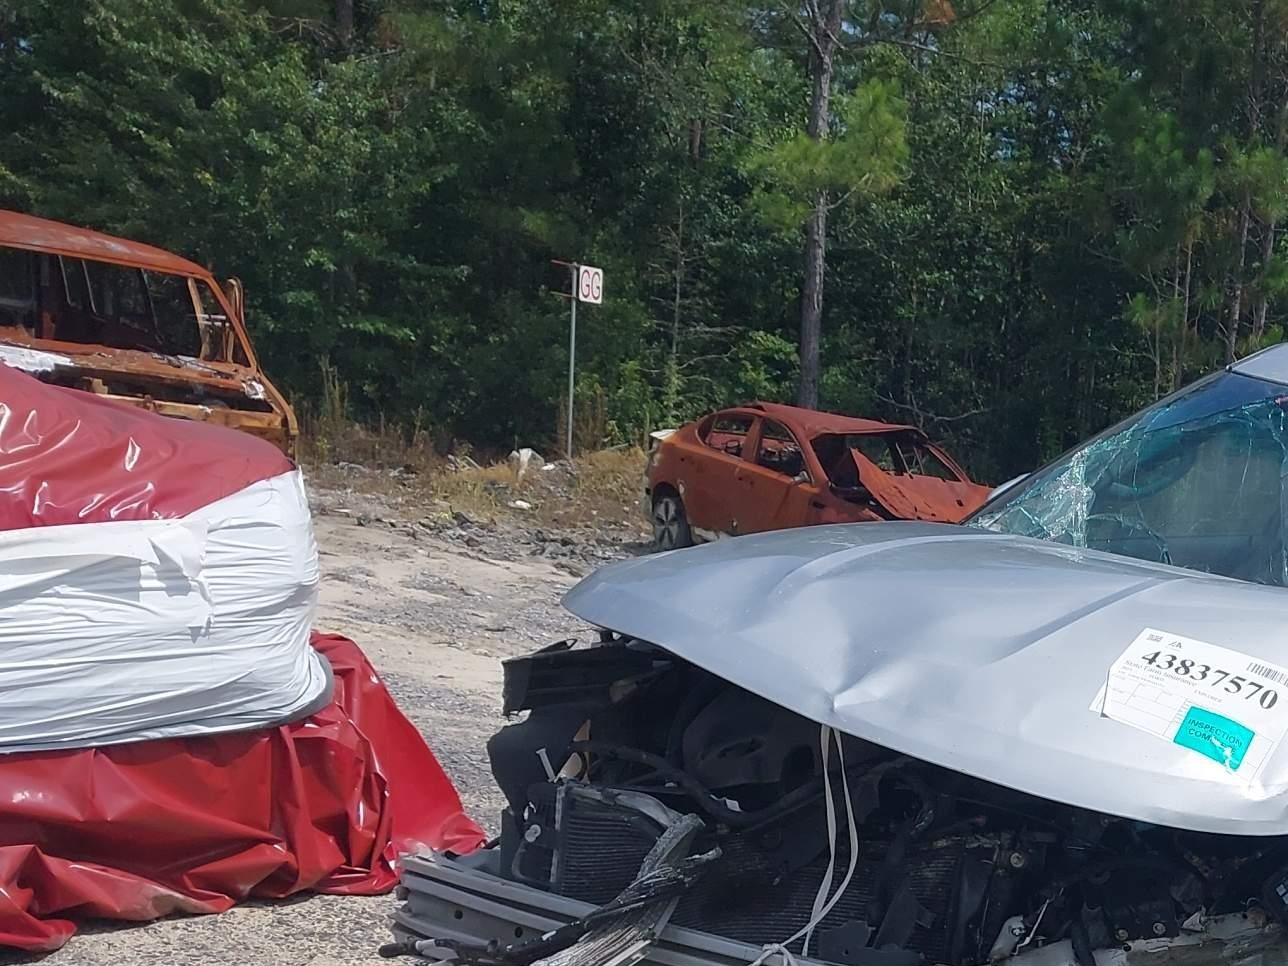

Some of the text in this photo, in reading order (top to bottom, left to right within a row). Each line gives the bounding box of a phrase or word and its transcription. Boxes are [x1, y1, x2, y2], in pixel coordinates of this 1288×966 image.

[581, 270, 600, 300] GG
[1141, 650, 1278, 710] 43837570
[1188, 718, 1243, 747] INSPECTION
